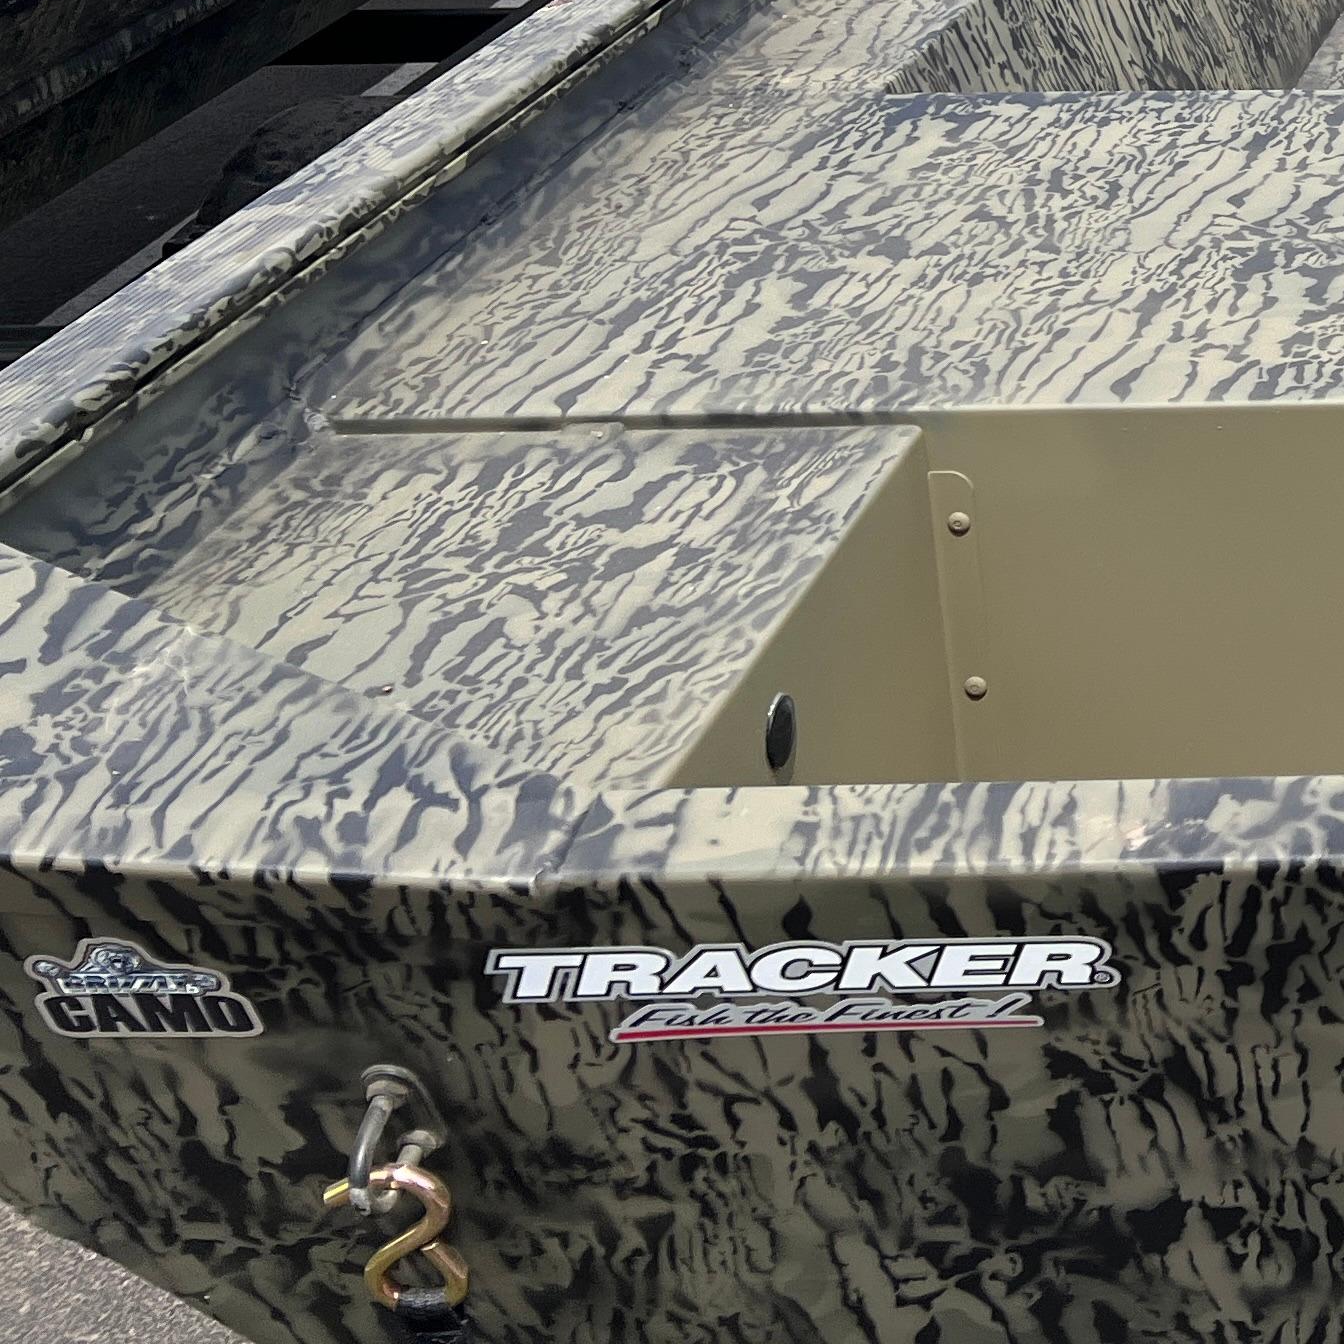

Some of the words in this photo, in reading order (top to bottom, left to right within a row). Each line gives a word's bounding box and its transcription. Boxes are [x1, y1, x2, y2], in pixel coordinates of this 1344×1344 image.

[499, 943, 1100, 998] TRACKER
[43, 994, 255, 1033] CAMO
[629, 1006, 733, 1029] Fish
[737, 1002, 817, 1024] the
[824, 999, 988, 1023] Finest
